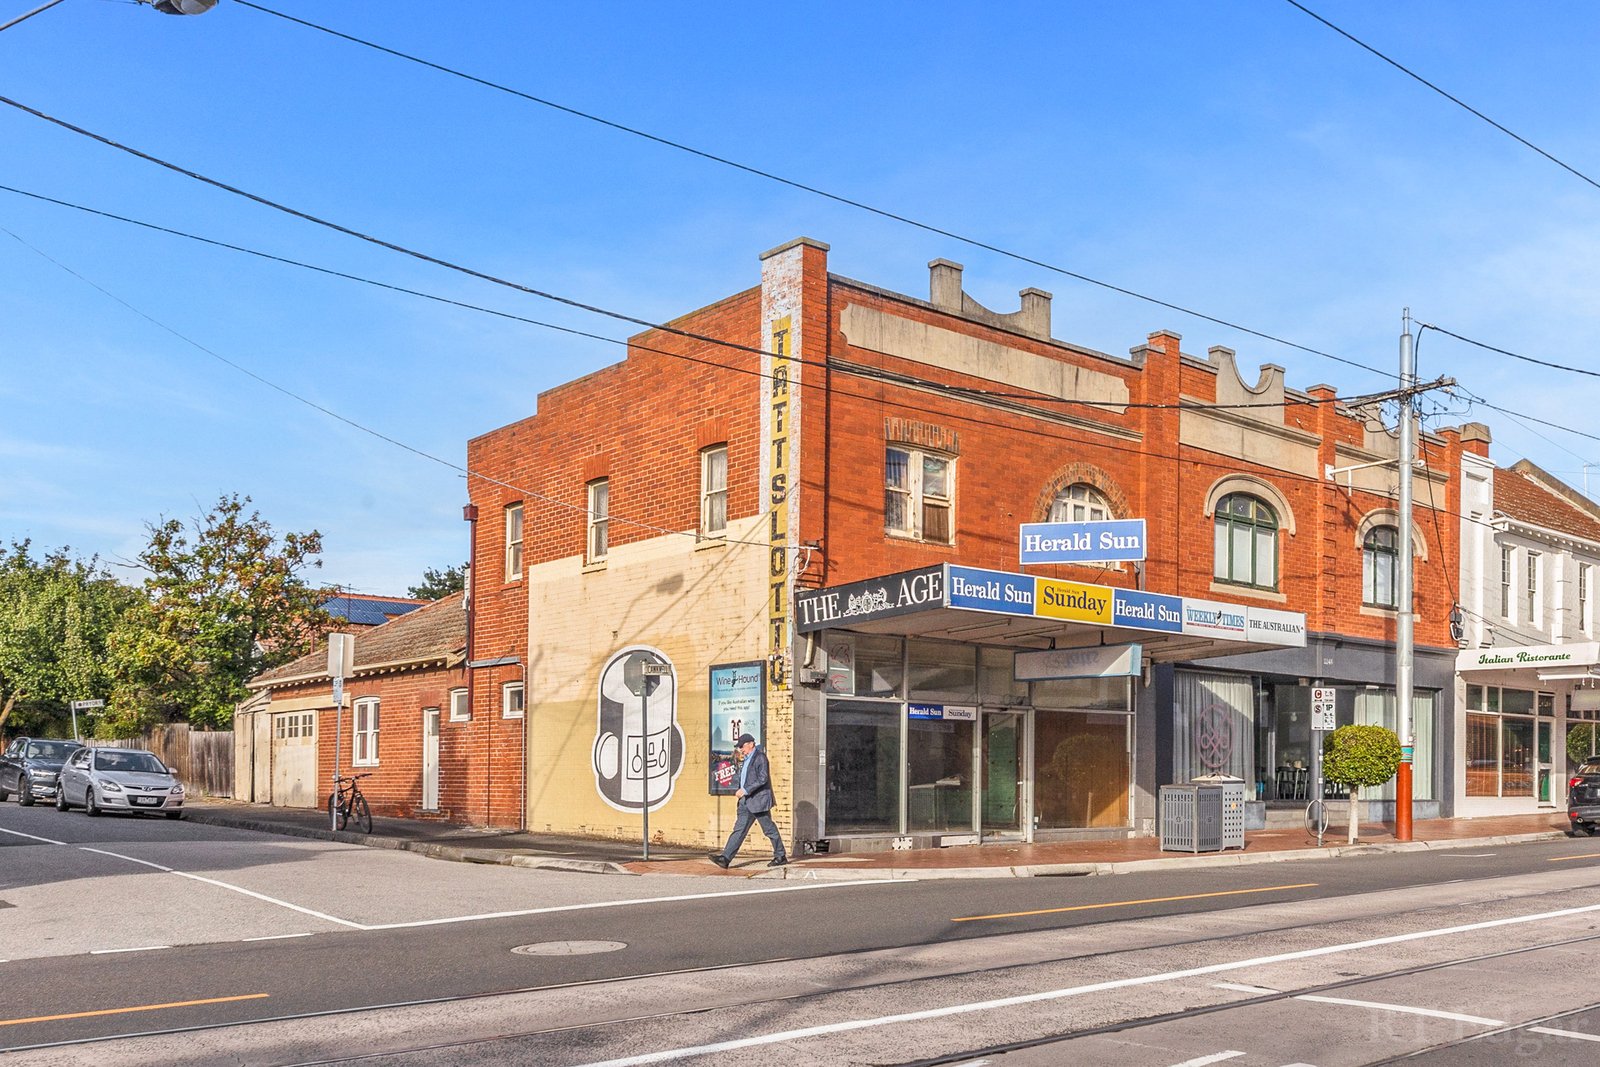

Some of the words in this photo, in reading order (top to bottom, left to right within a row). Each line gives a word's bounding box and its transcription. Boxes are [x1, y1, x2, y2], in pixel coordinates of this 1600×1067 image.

[1024, 532, 1092, 552] Herald
[1099, 531, 1140, 550] Sun
[798, 592, 842, 625] THE
[896, 571, 943, 607] AGE
[952, 576, 1001, 601] Herald
[1004, 583, 1033, 605] Sun
[1043, 585, 1107, 616] Sunday
[1115, 598, 1155, 619] Herald
[1158, 604, 1181, 623] Sun
[1186, 608, 1217, 624] WEEKLY
[1222, 613, 1244, 628] TIMES
[1249, 619, 1262, 629] THE
[1263, 621, 1301, 633] AUSTRALIAN
[1478, 654, 1514, 665] Italian
[1516, 651, 1571, 663] Ristorante
[716, 677, 731, 686] Wine
[738, 674, 759, 684] Hound
[909, 706, 929, 715] Herald
[930, 708, 942, 716] Sun
[948, 708, 972, 718] Sunday
[714, 765, 736, 781] FREE
